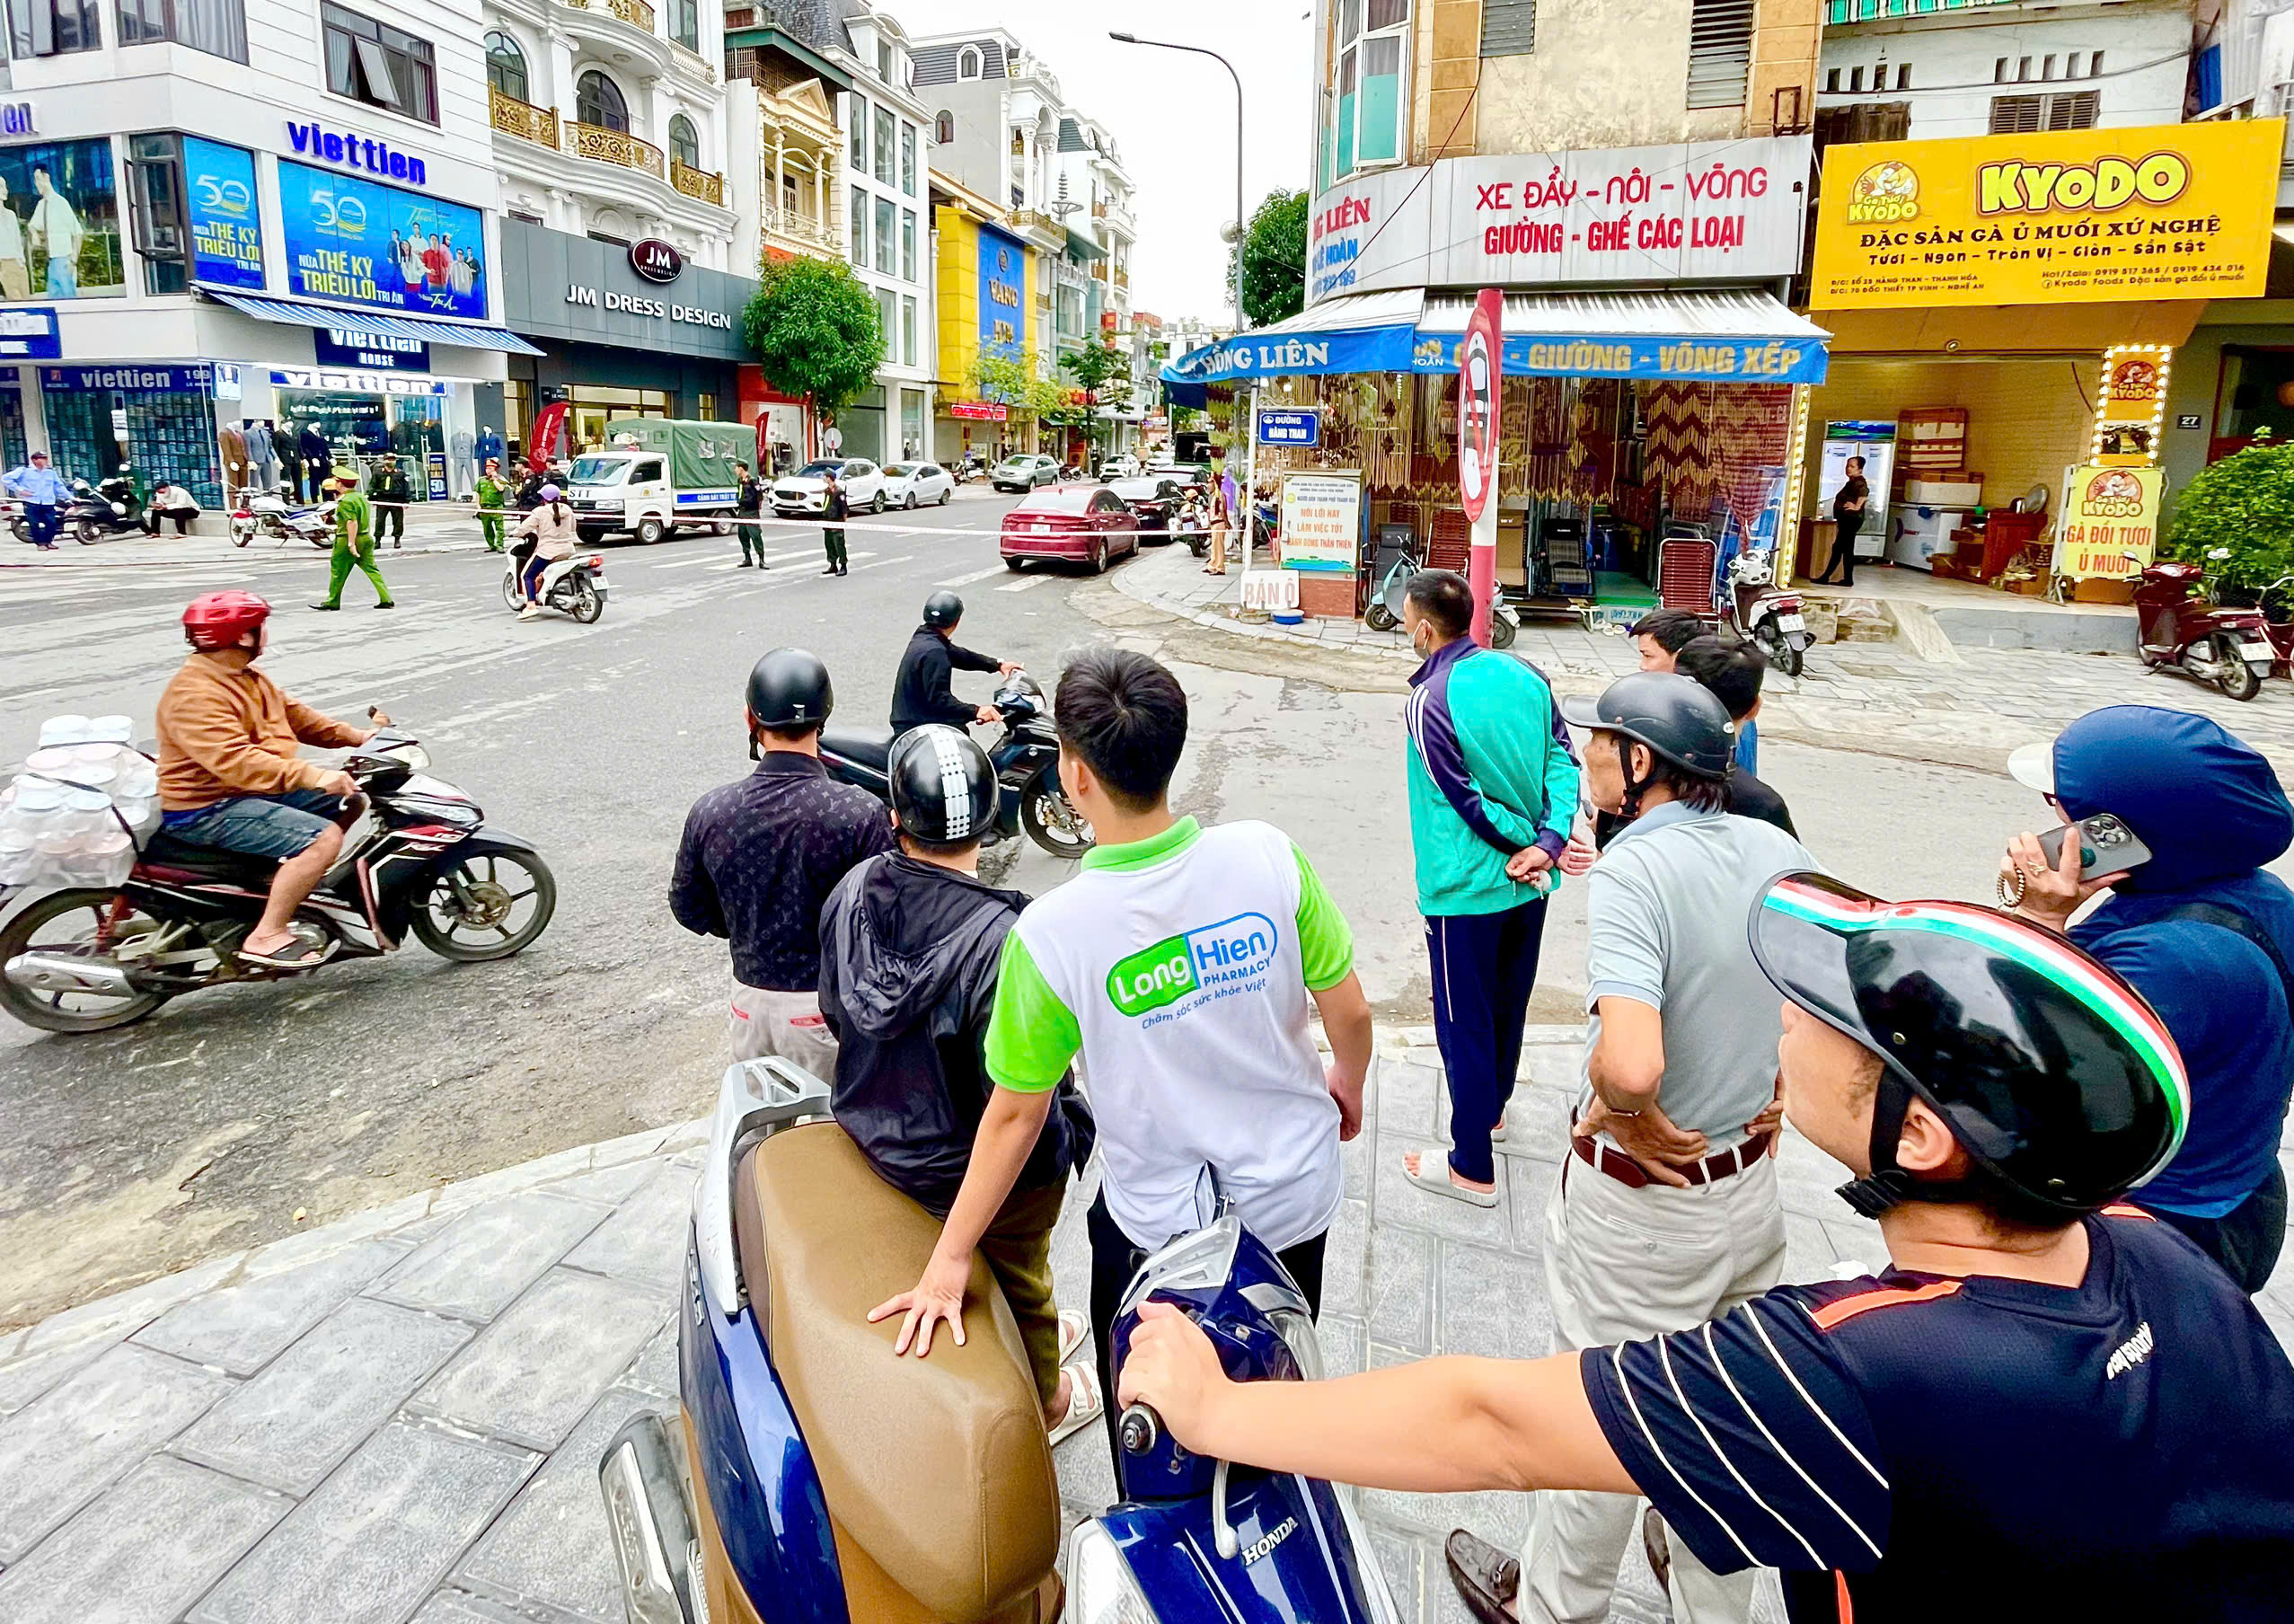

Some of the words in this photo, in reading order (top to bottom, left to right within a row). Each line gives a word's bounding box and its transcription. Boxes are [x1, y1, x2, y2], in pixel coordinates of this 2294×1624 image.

[287, 121, 426, 185] viettien
[1476, 181, 1513, 211] XE
[1523, 164, 1577, 209] ĐẨY
[1979, 153, 2189, 214] KYODO
[1327, 195, 1371, 234] LIÊN
[1848, 201, 1919, 222] KYODO
[1484, 216, 1564, 255] GIƯỜNG
[1587, 210, 1633, 252] GHẾ
[1637, 213, 1683, 250] CÁC
[1690, 215, 1745, 253] LOẠI
[1860, 229, 1909, 250] ĐẶC
[1914, 225, 1964, 245] SẢN
[1971, 224, 2005, 243] GÀ
[2013, 221, 2030, 241] Ủ
[2034, 216, 2099, 240] MUỐI
[2106, 216, 2145, 237] XỨ
[2149, 215, 2222, 237] NGHỆ
[315, 248, 349, 275] THẾ
[646, 246, 672, 269] JM
[1326, 236, 1359, 267] HOÀN
[1868, 253, 1906, 266] Tươi
[1924, 252, 1966, 265] Ngon
[1987, 245, 2031, 261] Tròn
[2036, 247, 2052, 262] Vị
[2073, 242, 2112, 258] Giòn
[299, 269, 349, 296] TRIỆU
[351, 277, 376, 302] LỜI
[2054, 279, 2087, 288] Kyodo
[2093, 277, 2124, 286] Foods
[376, 289, 391, 304] TRI
[566, 284, 597, 307] JM
[604, 291, 666, 319] DRESS
[670, 304, 732, 331] DESIGN
[358, 351, 395, 367] HOUSE
[1198, 345, 1254, 375] HỒNG
[1259, 338, 1330, 370] LIÊN
[1529, 340, 1632, 372] GIƯỜNG
[1659, 341, 1735, 374] VÕNG
[1742, 340, 1802, 375] XẾP
[81, 369, 172, 388] viettien
[2111, 387, 2157, 401] KYODO
[1268, 426, 1288, 439] HÀNG
[1289, 428, 1307, 440] THAN
[1275, 414, 1302, 426] ĐƯỜNG
[2182, 416, 2198, 426] 27
[1327, 509, 1341, 518] HAY
[2082, 501, 2143, 518] KYODO
[2067, 520, 2086, 543] GÀ
[2119, 526, 2152, 546] TƯƠI
[2078, 548, 2089, 572] Ủ
[1244, 577, 1280, 605] BÁN
[1114, 953, 1192, 1005] Long
[1196, 929, 1268, 971] Hien
[1203, 957, 1271, 987] PHARMACY
[1142, 1011, 1173, 1030] Chăm
[1177, 1002, 1192, 1019] sóc
[1193, 993, 1213, 1008] sức
[1214, 984, 1242, 1000] khỏe
[1245, 977, 1267, 993] Việt
[1241, 1516, 1300, 1568] HONDA
